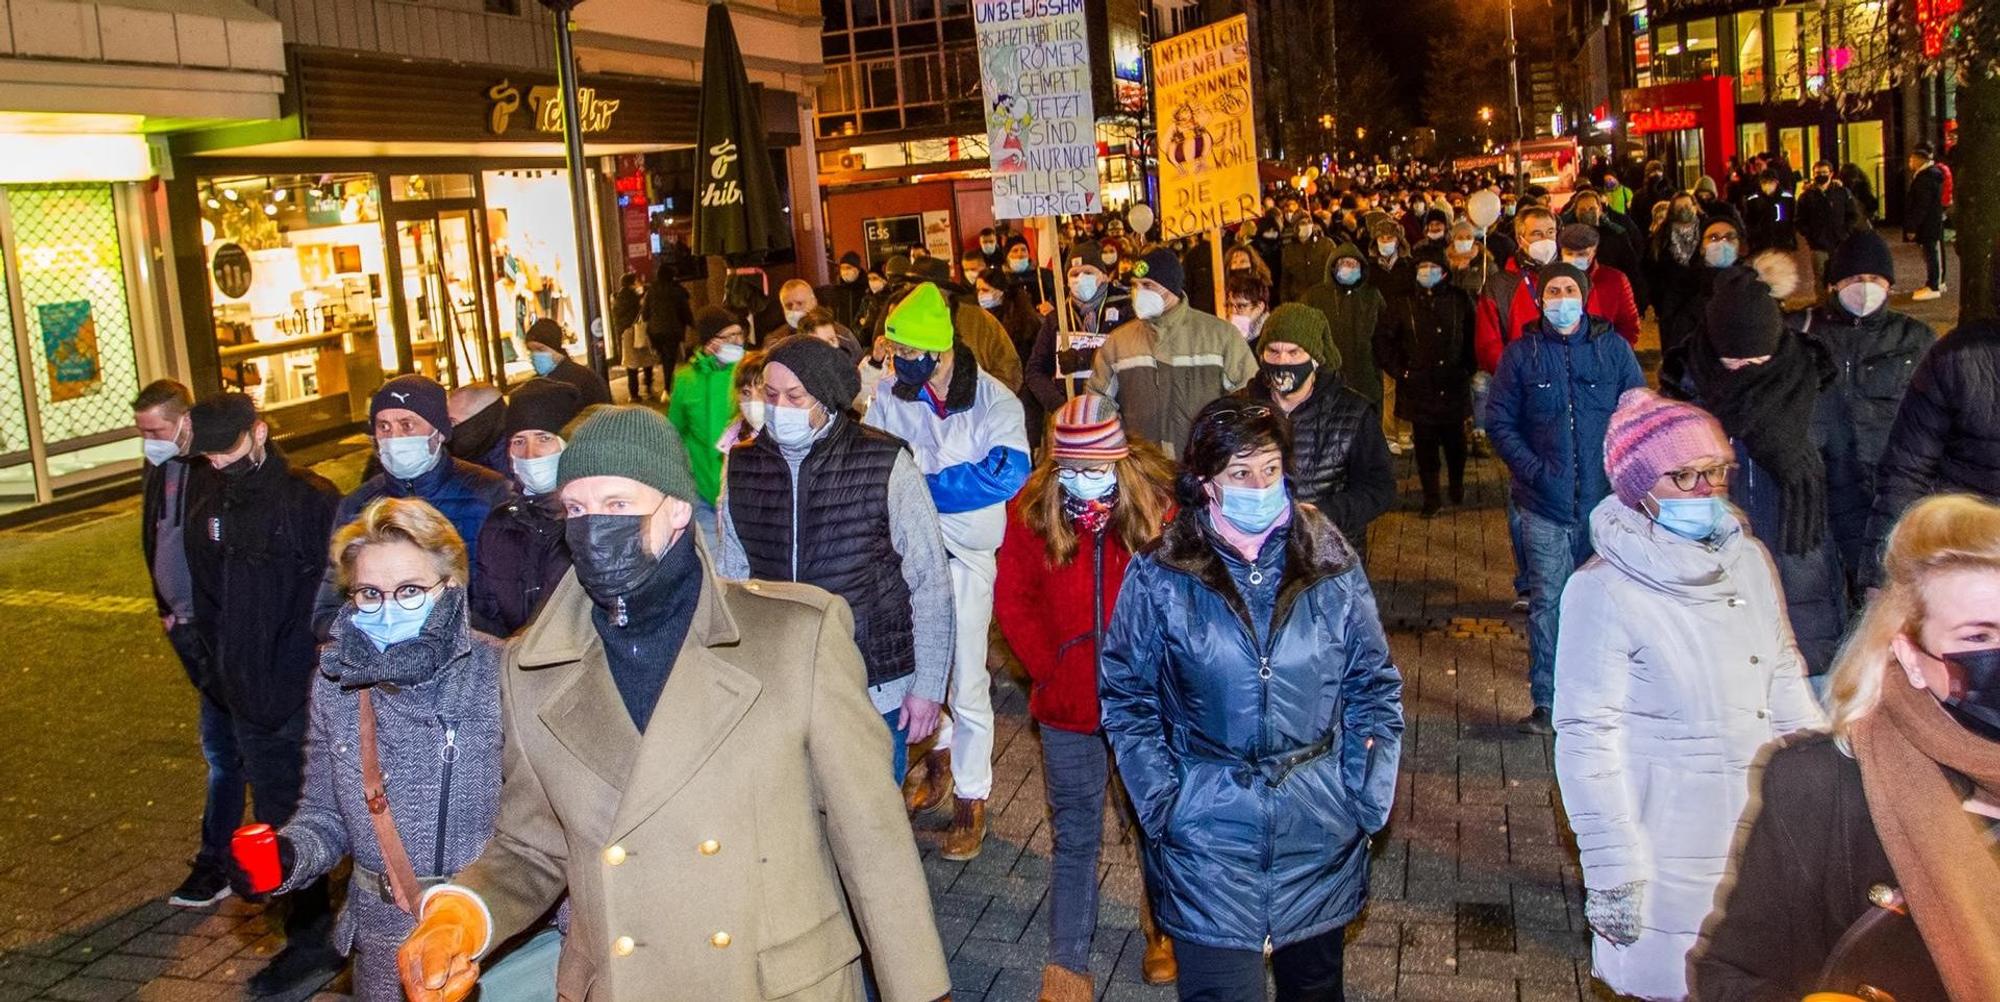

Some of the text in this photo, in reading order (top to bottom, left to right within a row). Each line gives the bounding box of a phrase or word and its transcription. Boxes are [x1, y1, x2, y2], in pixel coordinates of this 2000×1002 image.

[976, 0, 1083, 24] UNBEUGSAM
[1019, 42, 1086, 71] RÖMER
[1032, 95, 1081, 120] JETZT
[1029, 120, 1077, 146] SIND
[993, 168, 1090, 197] GALLIER
[1176, 180, 1212, 209] DIE
[1163, 192, 1262, 241] RÖMER
[281, 303, 339, 336] COFFEE
